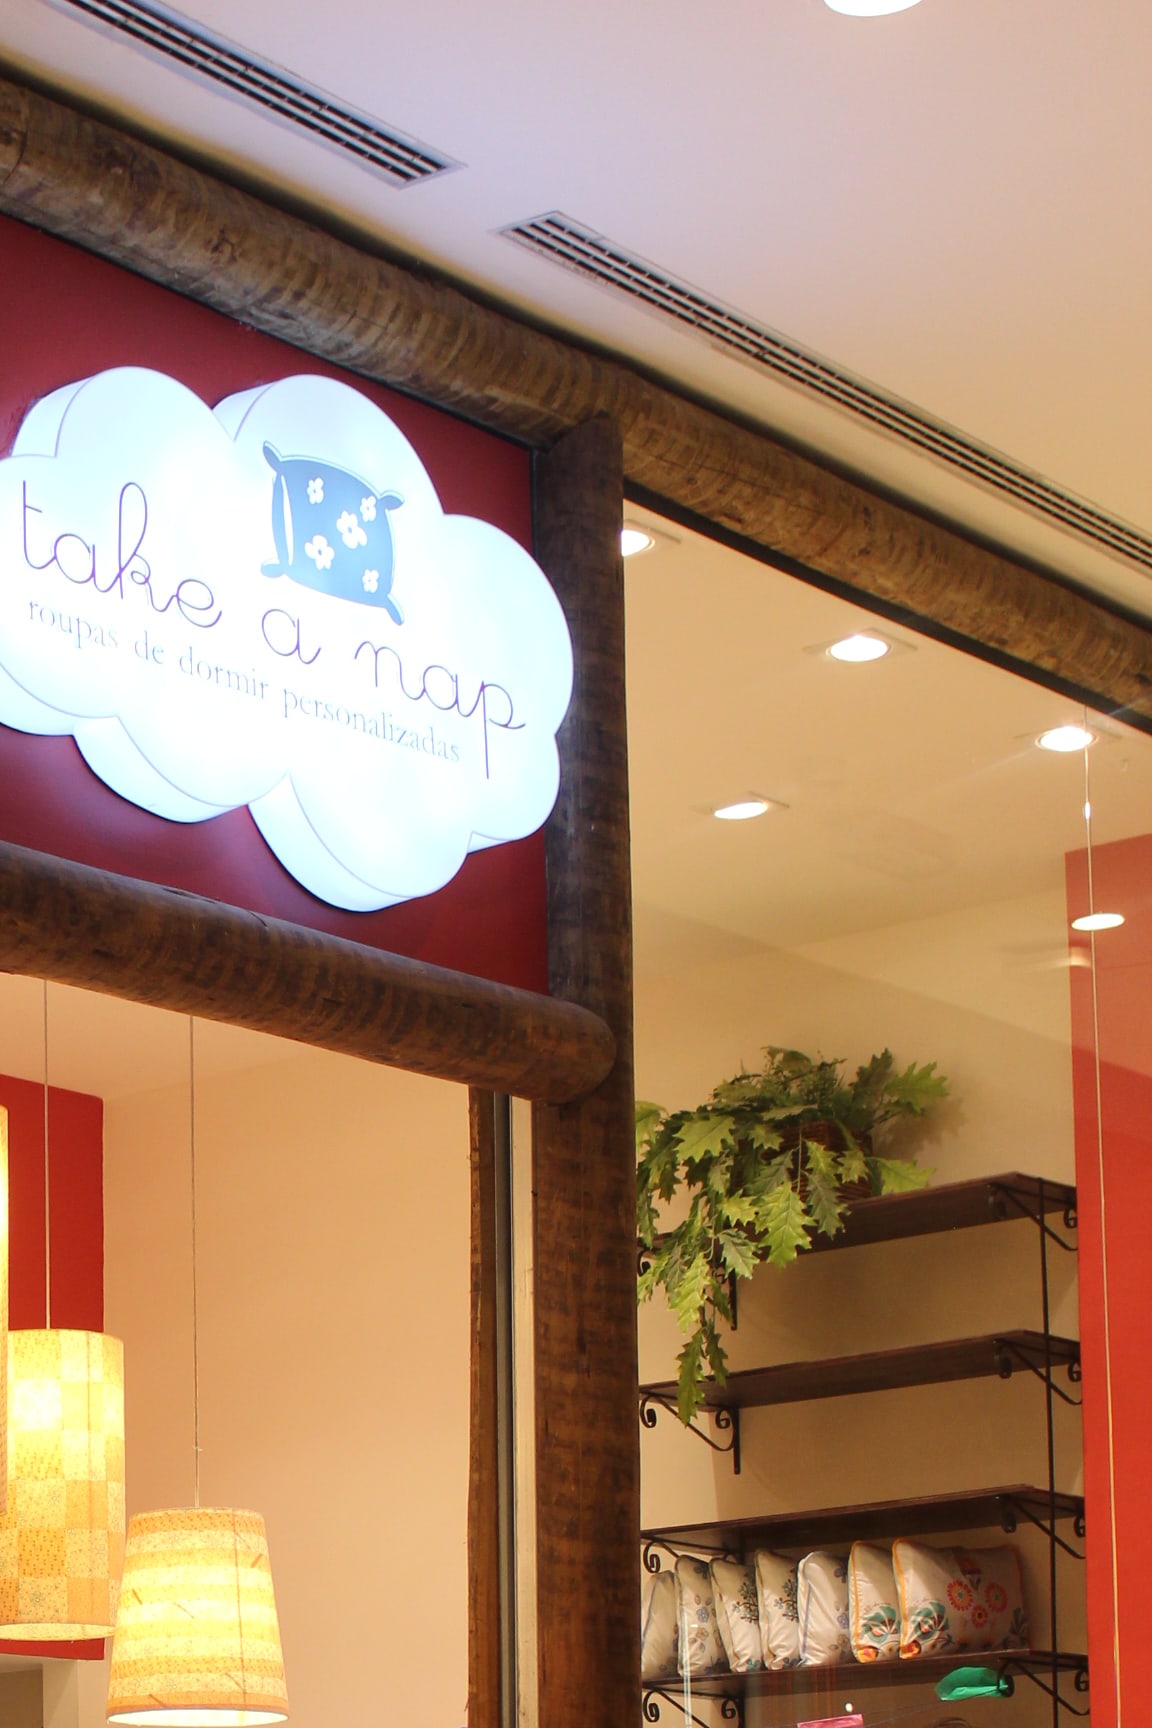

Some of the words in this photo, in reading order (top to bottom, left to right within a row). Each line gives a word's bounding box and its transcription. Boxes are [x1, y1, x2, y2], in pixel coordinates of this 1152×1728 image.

[22, 480, 222, 628] take
[261, 608, 322, 665] a
[354, 640, 526, 780] nap
[28, 600, 119, 649] roupas
[133, 630, 165, 665] de
[179, 645, 269, 700] dormir
[283, 687, 461, 763] personalizadas
